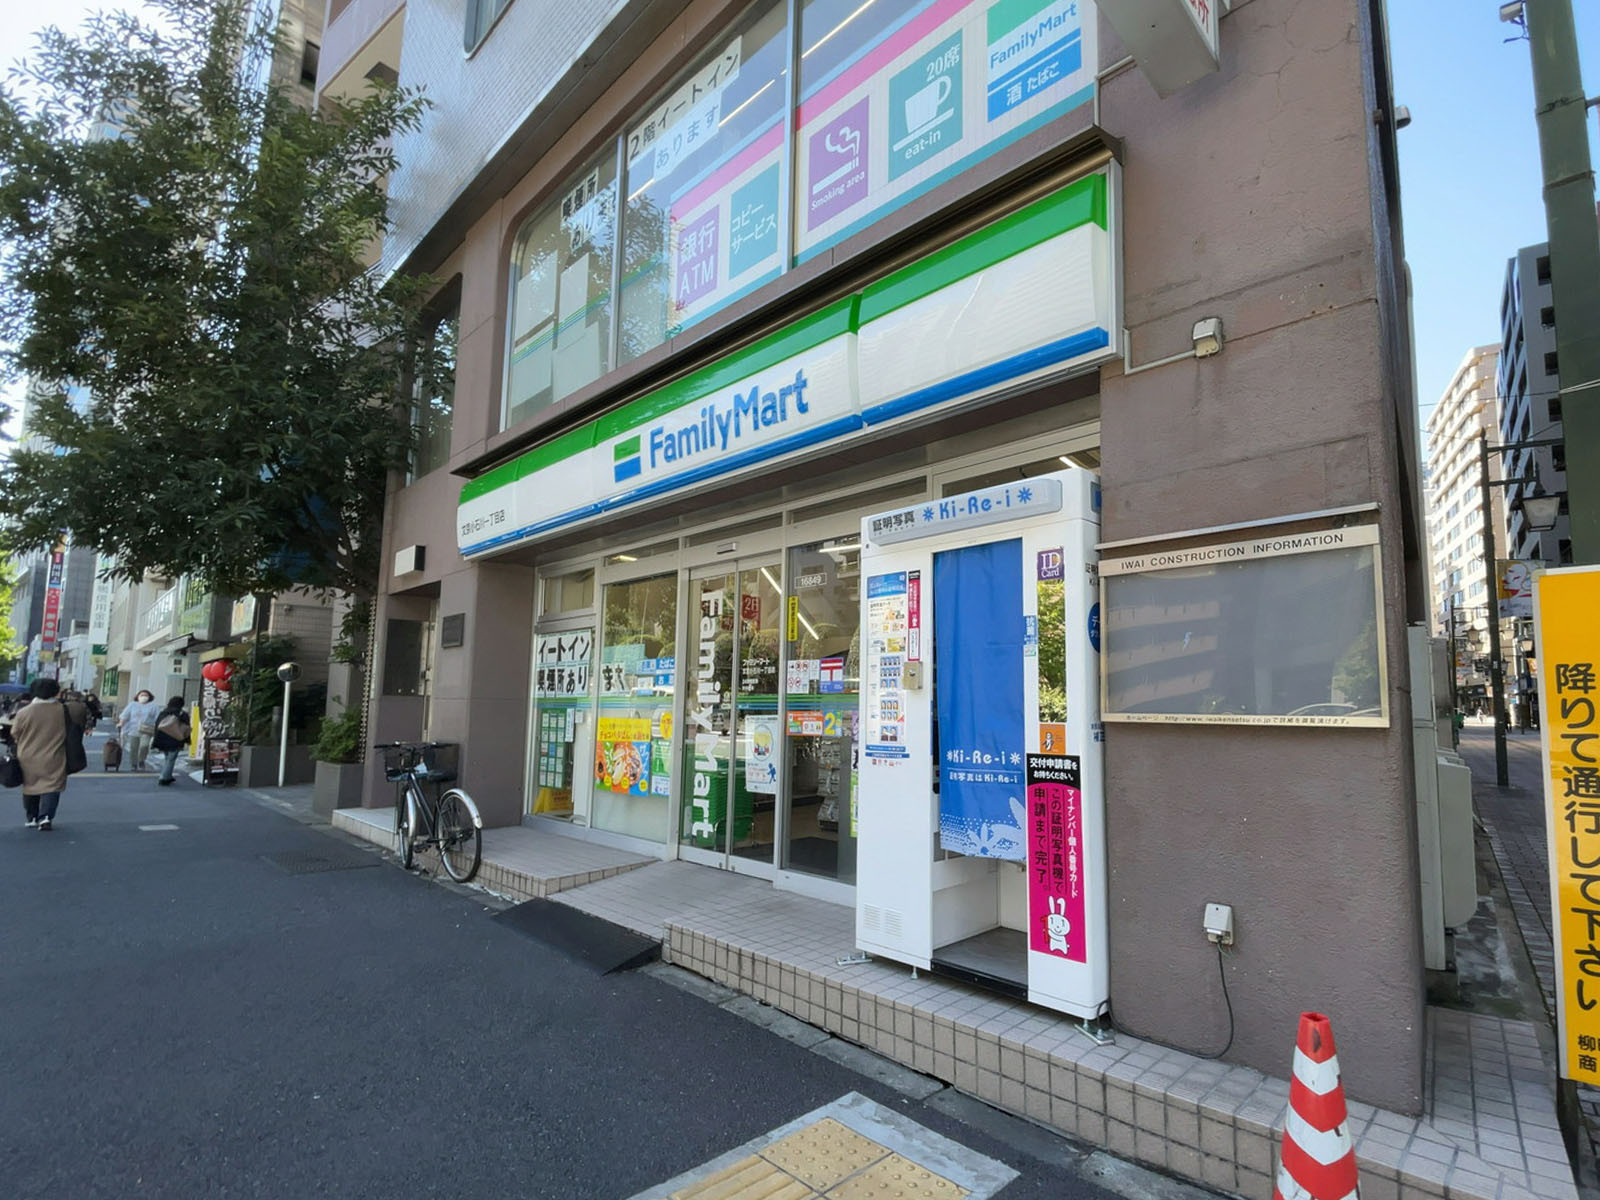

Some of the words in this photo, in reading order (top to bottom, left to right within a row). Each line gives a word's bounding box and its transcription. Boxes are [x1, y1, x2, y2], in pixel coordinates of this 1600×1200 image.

[991, 1, 1077, 69] FamilyMart
[926, 44, 961, 82] 20席
[1007, 84, 1022, 105] 酒
[1027, 62, 1061, 92] たばこ
[656, 105, 719, 169] あります
[905, 130, 941, 160] eat-in
[812, 184, 845, 211] Smoking
[847, 171, 865, 189] area
[731, 203, 764, 233] コピー
[731, 213, 777, 255] サービス
[681, 220, 716, 265] 銀行
[679, 258, 715, 299] ATM
[650, 369, 809, 469] FamilyMart
[872, 510, 915, 532] 証明写真
[939, 490, 1011, 520] Ki-Re-i
[1041, 551, 1061, 569] ID
[1121, 560, 1145, 570] IWAI
[1150, 546, 1246, 567] CONSTRUCTION
[1253, 533, 1344, 553] INFORMATION
[1041, 567, 1060, 580] Card
[538, 636, 591, 662] イートイン
[953, 750, 1006, 765] Ki-Re-i
[1029, 757, 1078, 770] 交付申請書を
[1050, 788, 1065, 894] この証明写真機で
[1067, 789, 1079, 899] マイナンバー個人番号カード
